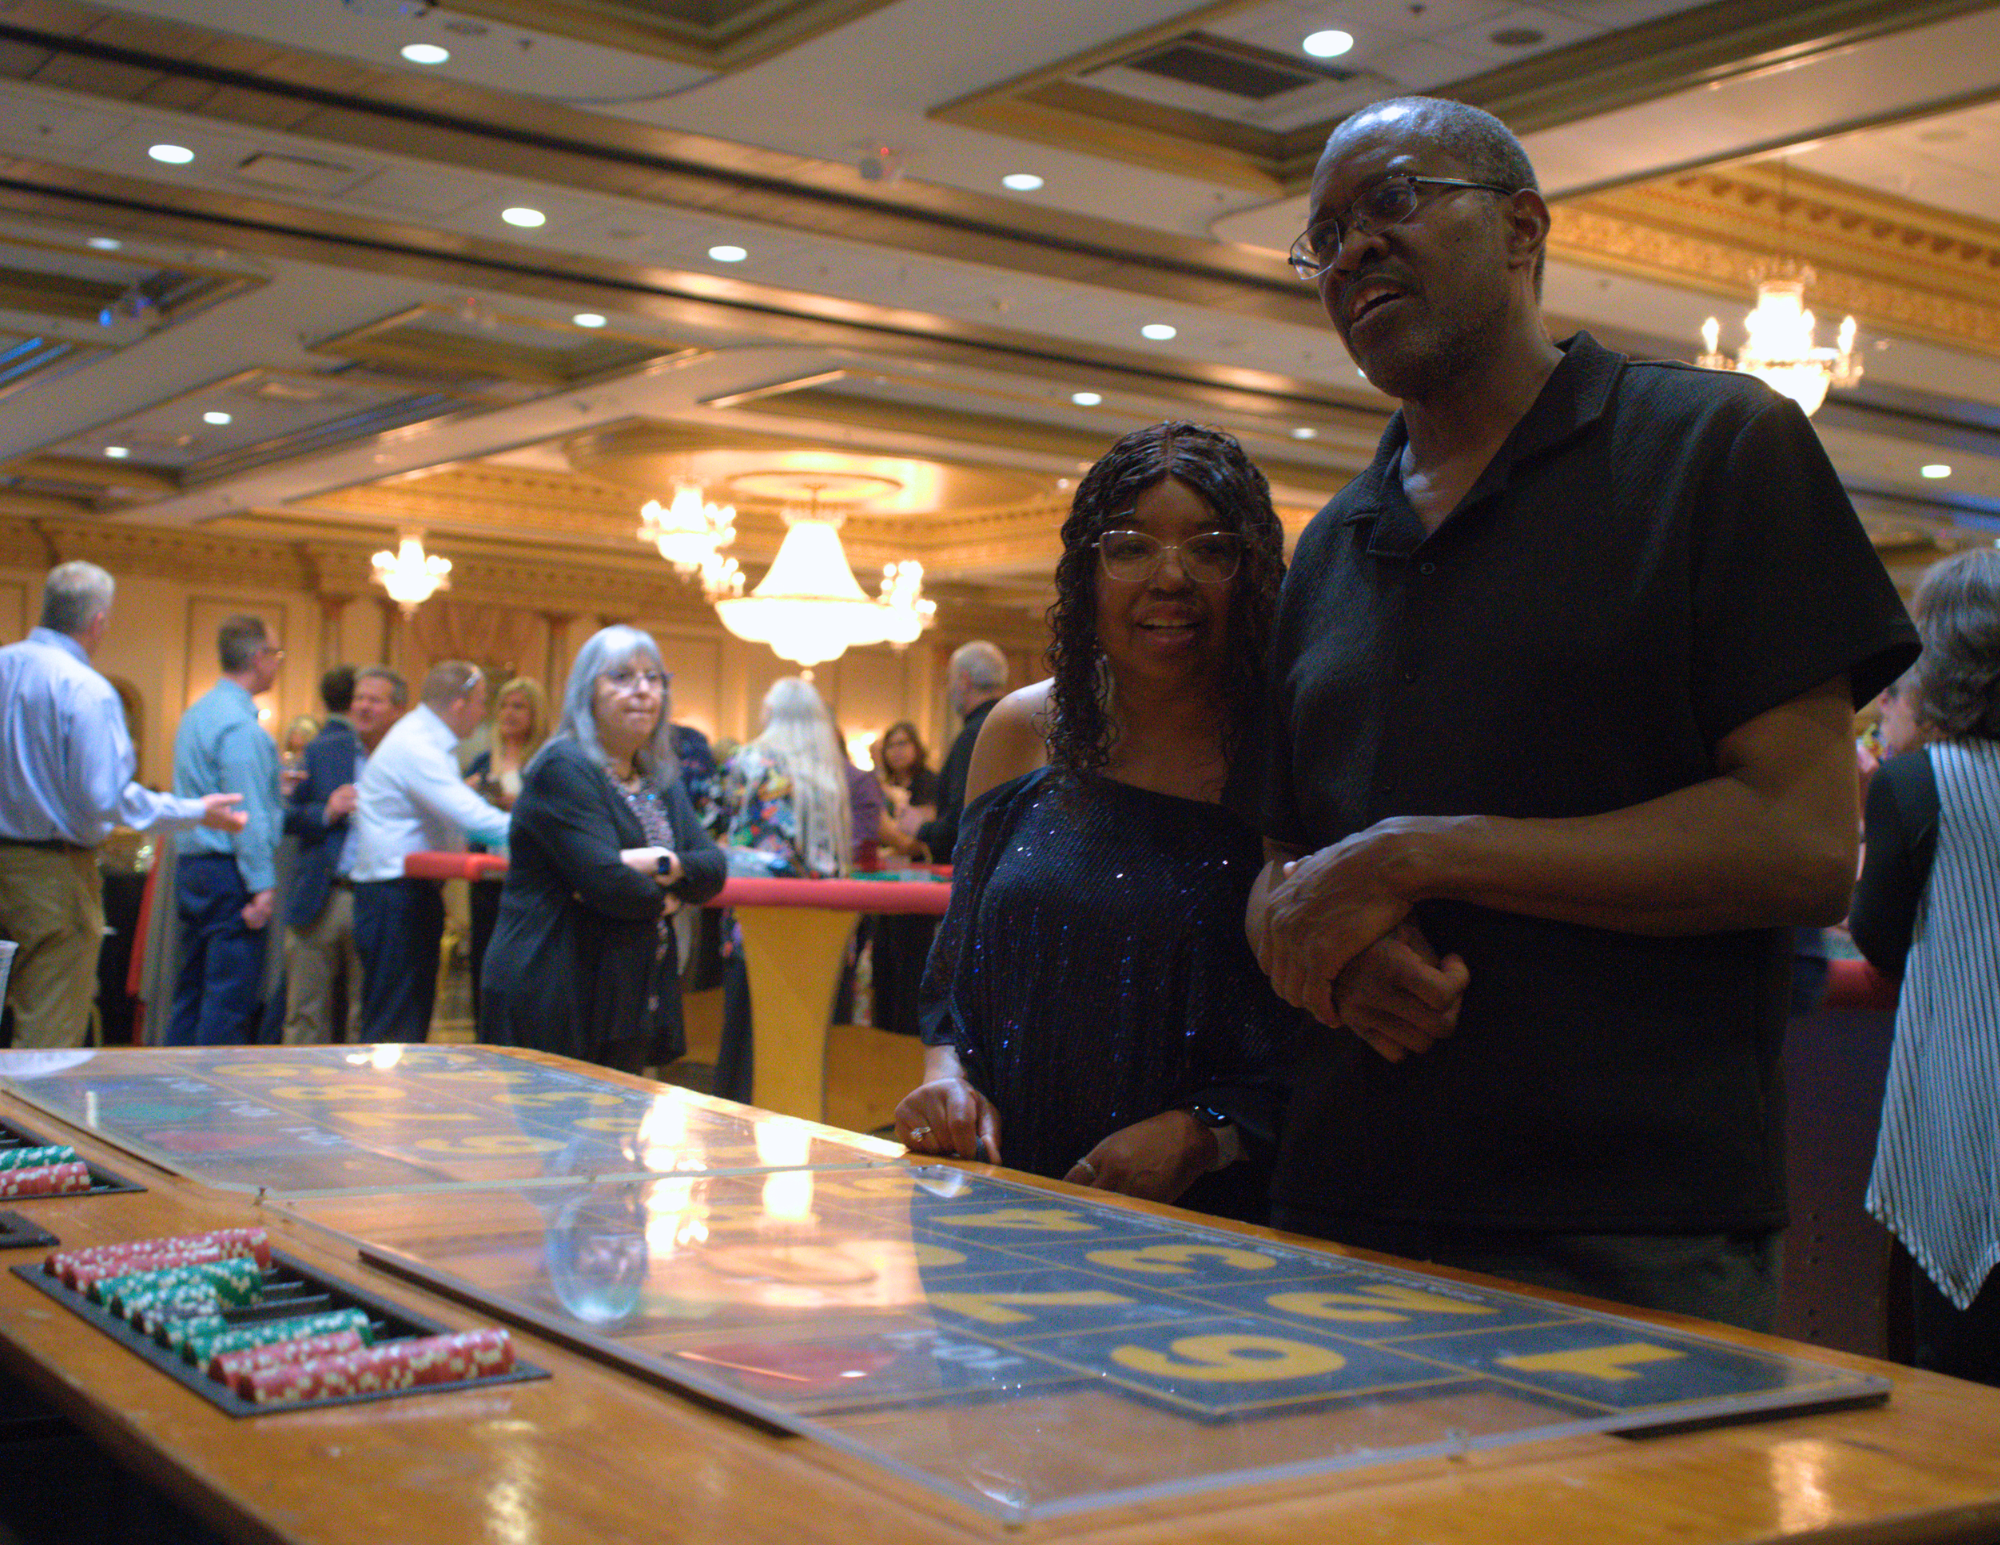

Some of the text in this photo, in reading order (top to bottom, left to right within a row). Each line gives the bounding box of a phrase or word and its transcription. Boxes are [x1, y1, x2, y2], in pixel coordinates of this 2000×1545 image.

[269, 1084, 407, 1101] 8
[414, 1135, 570, 1154] 6
[927, 1208, 1103, 1231] 4
[1085, 1244, 1278, 1274] 3
[920, 1289, 1140, 1324] 7
[1266, 1284, 1502, 1323] 2
[1110, 1334, 1347, 1382] 6
[1494, 1342, 1690, 1381] 1
